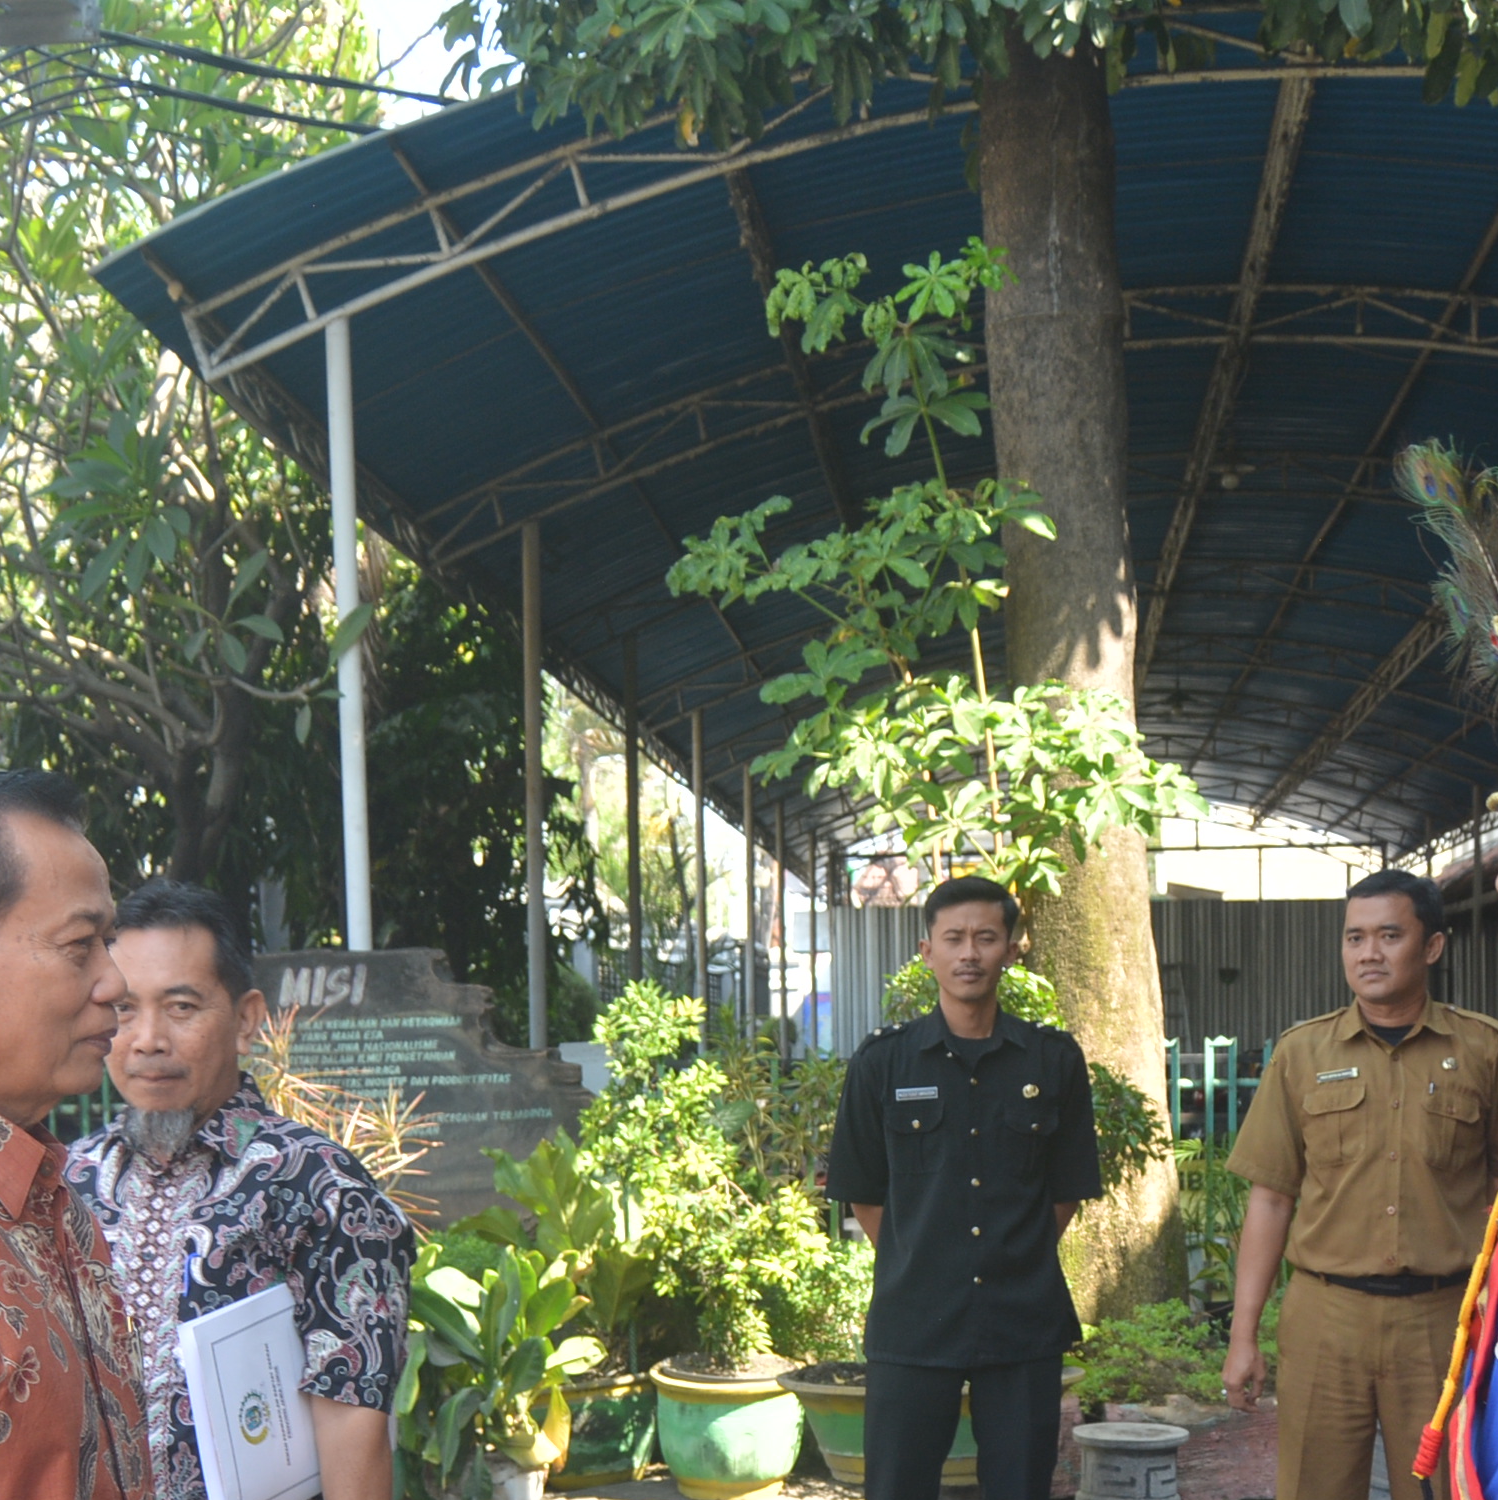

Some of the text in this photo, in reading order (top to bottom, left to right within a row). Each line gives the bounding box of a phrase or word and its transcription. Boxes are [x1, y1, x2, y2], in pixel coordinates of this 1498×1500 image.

[279, 963, 367, 1007] MISI
[380, 1017, 400, 1028] DAN
[301, 1031, 328, 1041] YANG
[331, 1030, 361, 1041] MAHA
[363, 1029, 384, 1040] ESA
[362, 1039, 438, 1051] NASIONALISME
[321, 1053, 354, 1064] DALAM
[385, 1050, 456, 1062] PENGETAHUAN
[410, 1076, 430, 1087] DAN
